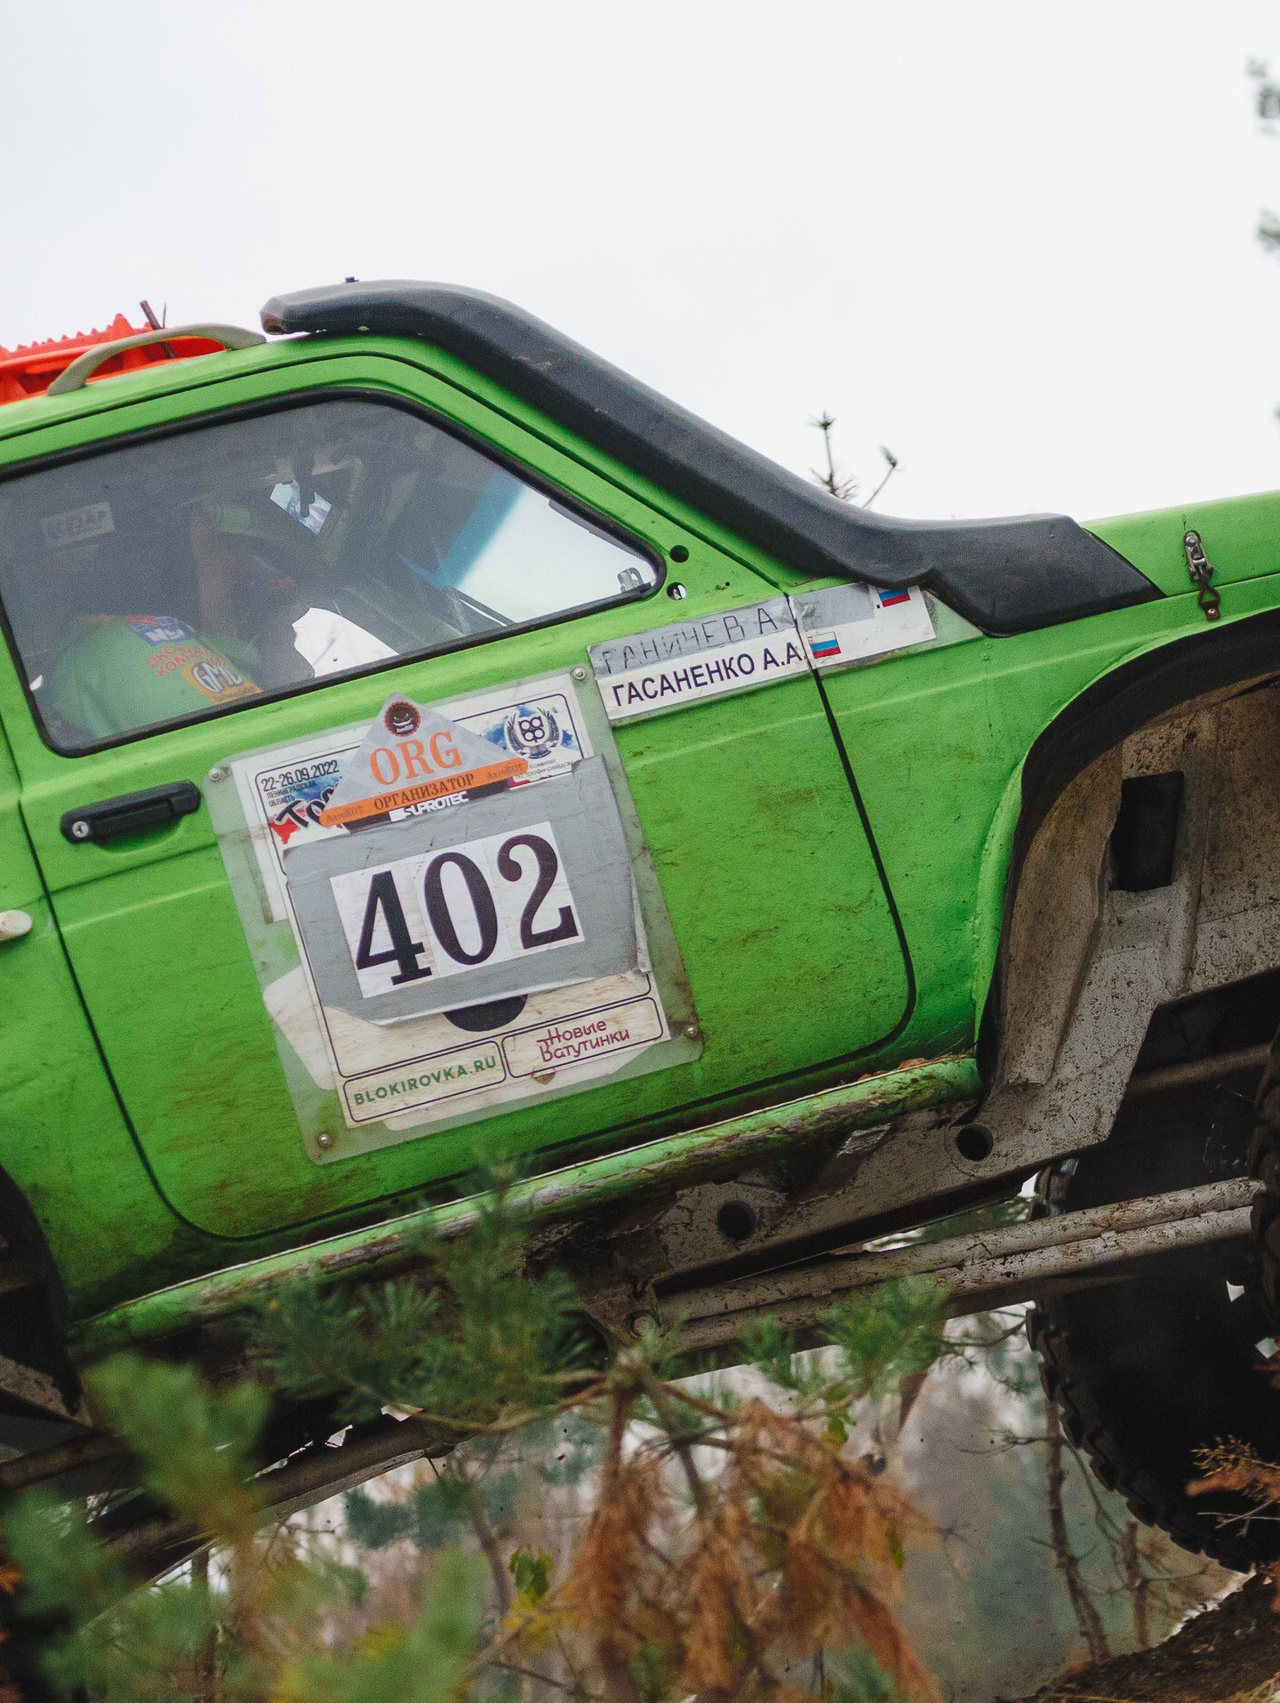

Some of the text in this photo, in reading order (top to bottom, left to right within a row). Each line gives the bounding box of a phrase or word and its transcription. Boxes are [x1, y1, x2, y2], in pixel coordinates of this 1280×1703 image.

[612, 653, 755, 707] ГАСАНЕНКО
[261, 759, 340, 792] 22-26.09.2022
[369, 730, 462, 785] ORG
[373, 773, 475, 811] ОРГАНИЗАТОР
[402, 791, 469, 818] SUPROTEC
[355, 834, 580, 986] 402
[536, 1020, 607, 1047] Новые
[539, 1029, 631, 1063] Ватутинки
[353, 1055, 498, 1106] BLOKIROVKA.RU
